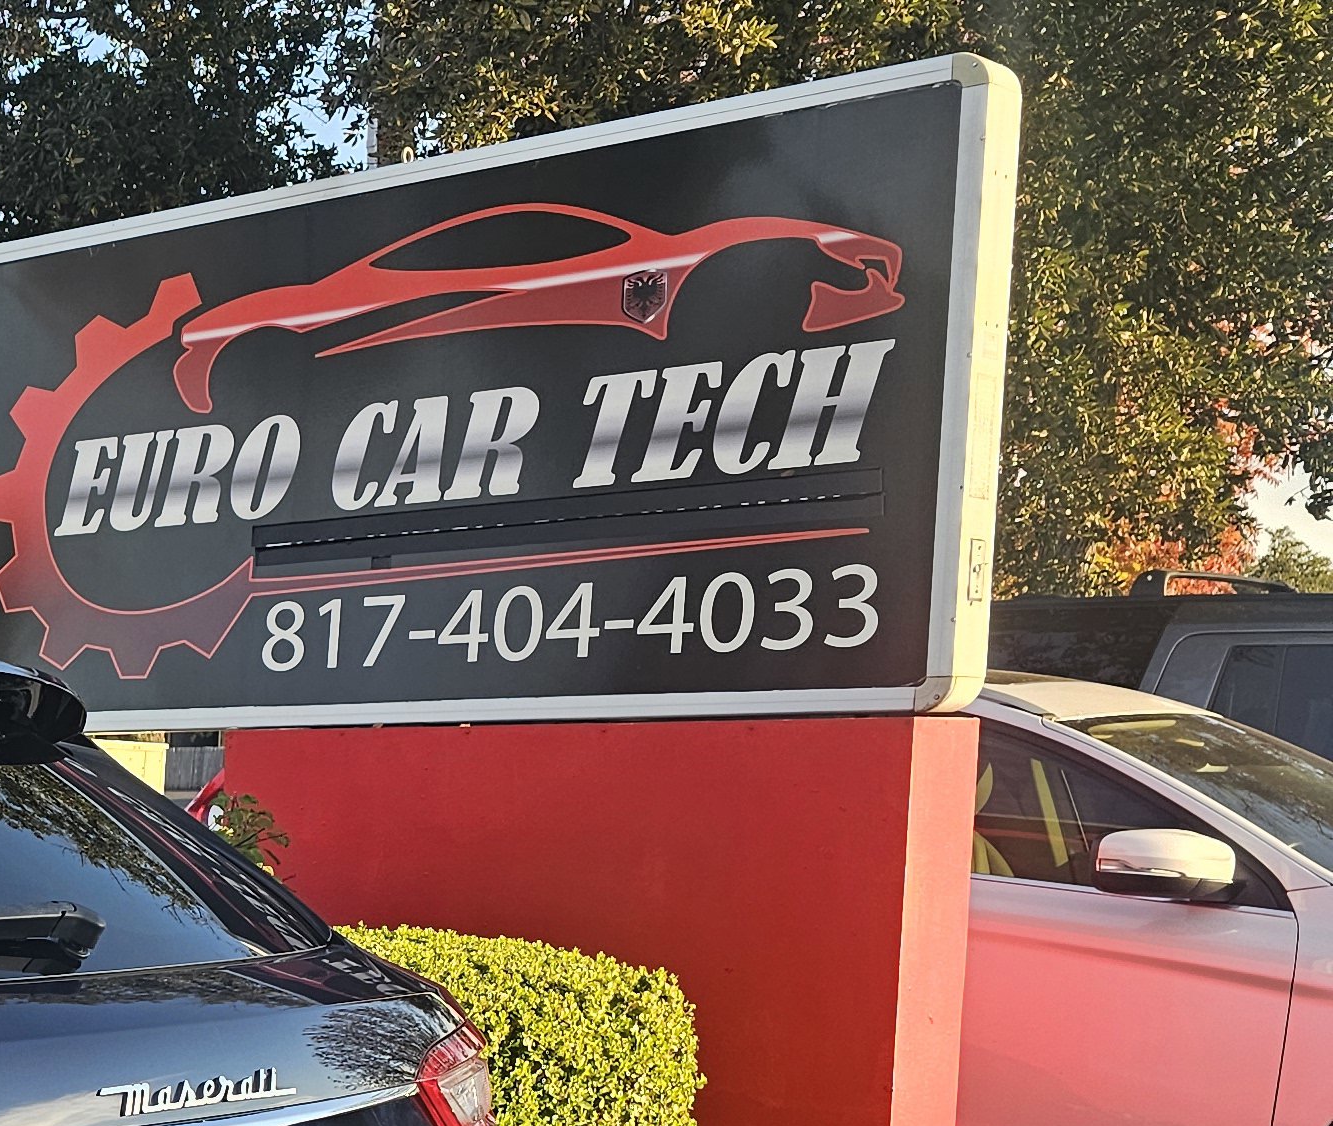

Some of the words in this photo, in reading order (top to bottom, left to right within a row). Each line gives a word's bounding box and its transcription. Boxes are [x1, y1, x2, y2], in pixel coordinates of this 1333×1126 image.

[54, 414, 301, 537] EURO
[332, 386, 539, 511] CAR
[572, 338, 896, 488] TECH
[262, 563, 879, 672] 817-404-4033
[97, 1066, 297, 1117] Maserati
